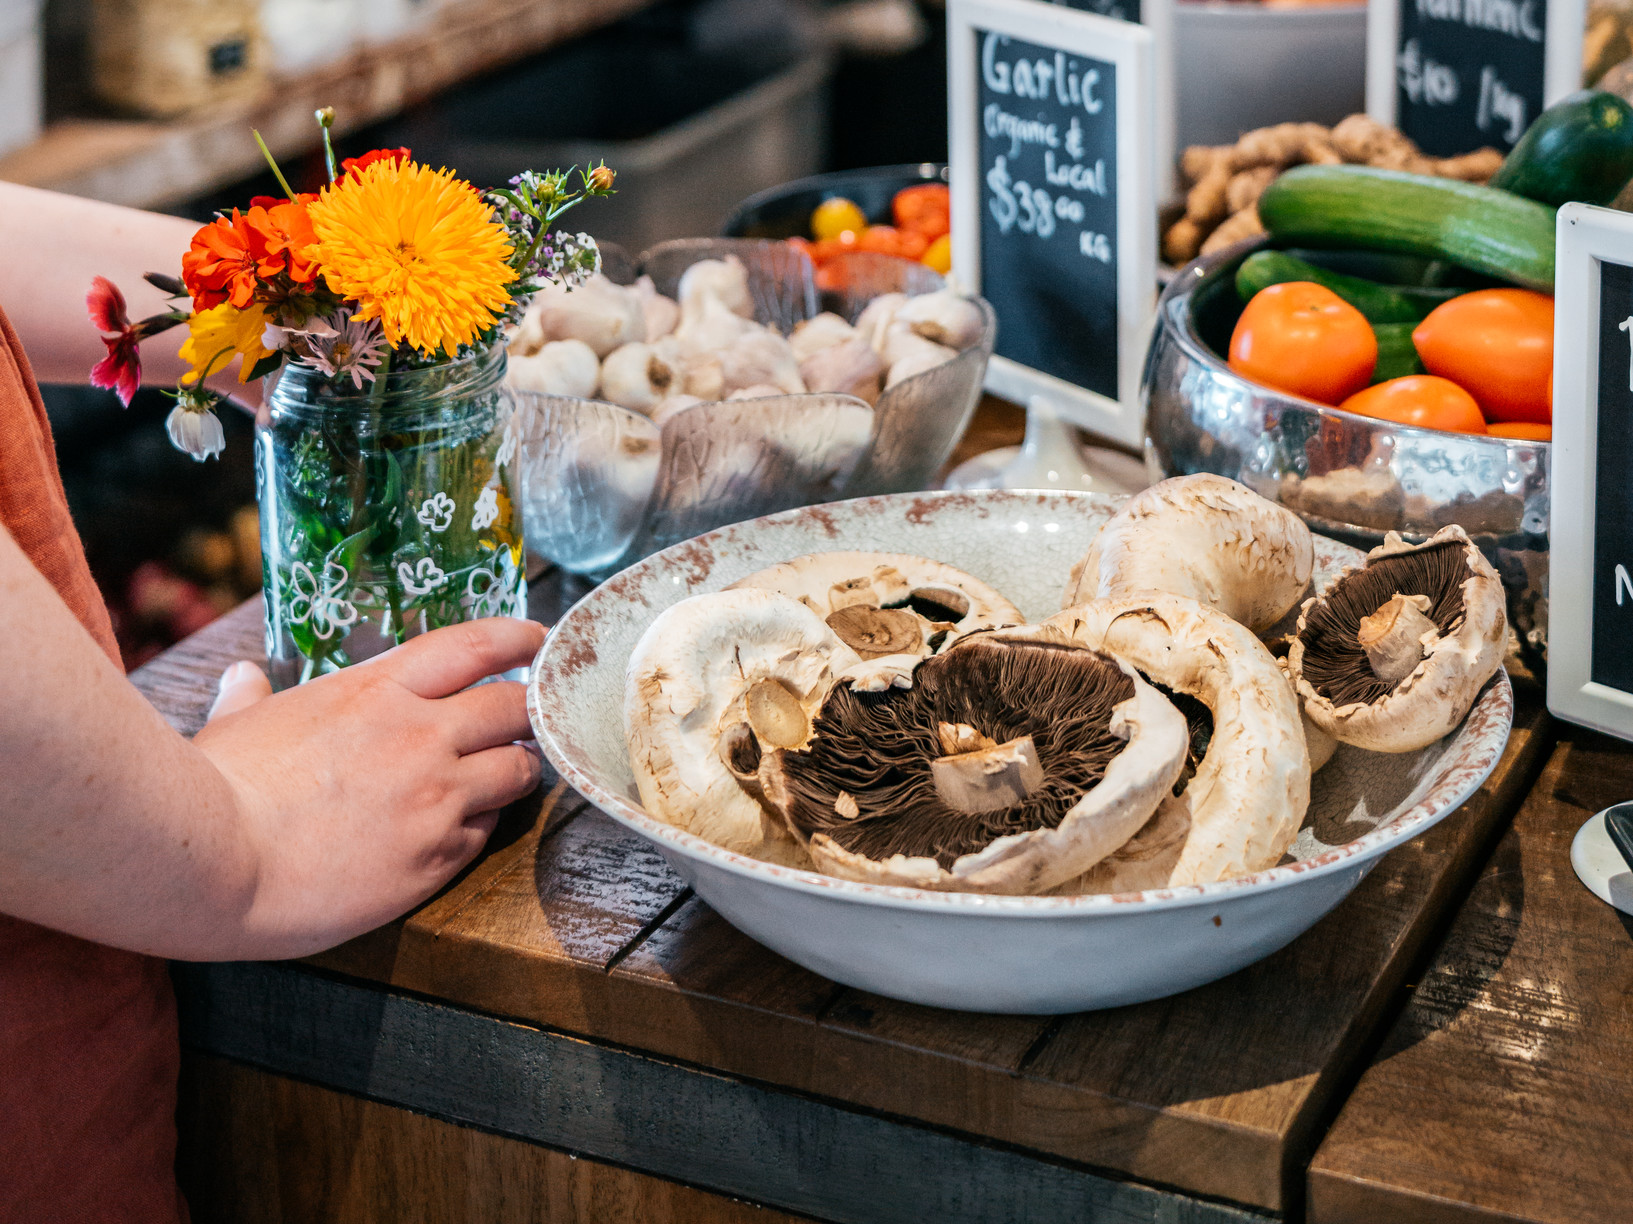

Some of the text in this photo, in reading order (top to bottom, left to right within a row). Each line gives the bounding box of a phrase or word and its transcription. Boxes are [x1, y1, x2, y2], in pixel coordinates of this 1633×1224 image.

[982, 31, 1102, 114] Garlic
[984, 102, 1060, 160] Organic
[1045, 149, 1107, 197] Local
